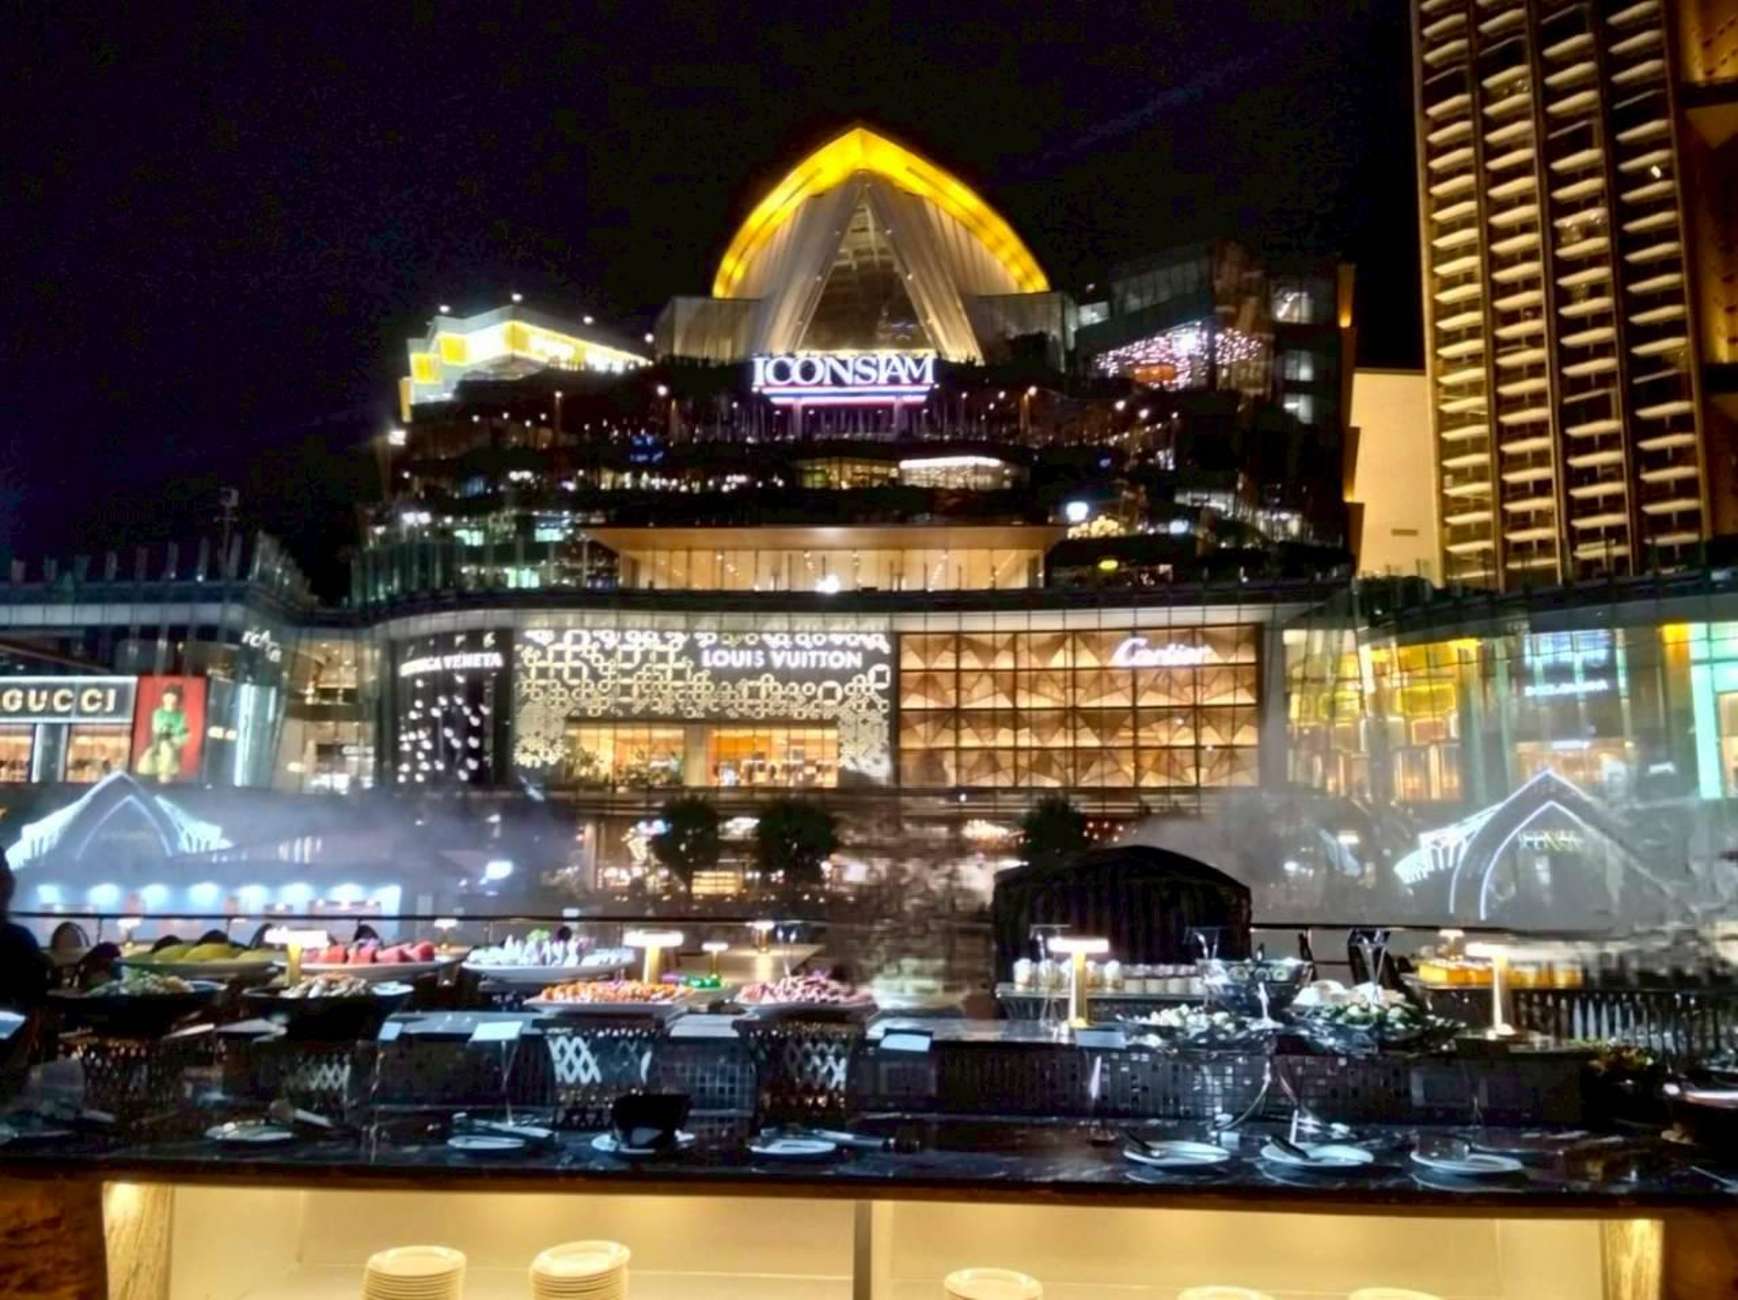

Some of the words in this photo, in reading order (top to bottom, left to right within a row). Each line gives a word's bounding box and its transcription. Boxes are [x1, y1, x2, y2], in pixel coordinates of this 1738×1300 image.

[752, 353, 936, 386] ICONSIAM
[701, 650, 764, 668] LOUIS
[770, 651, 862, 669] VUITTON
